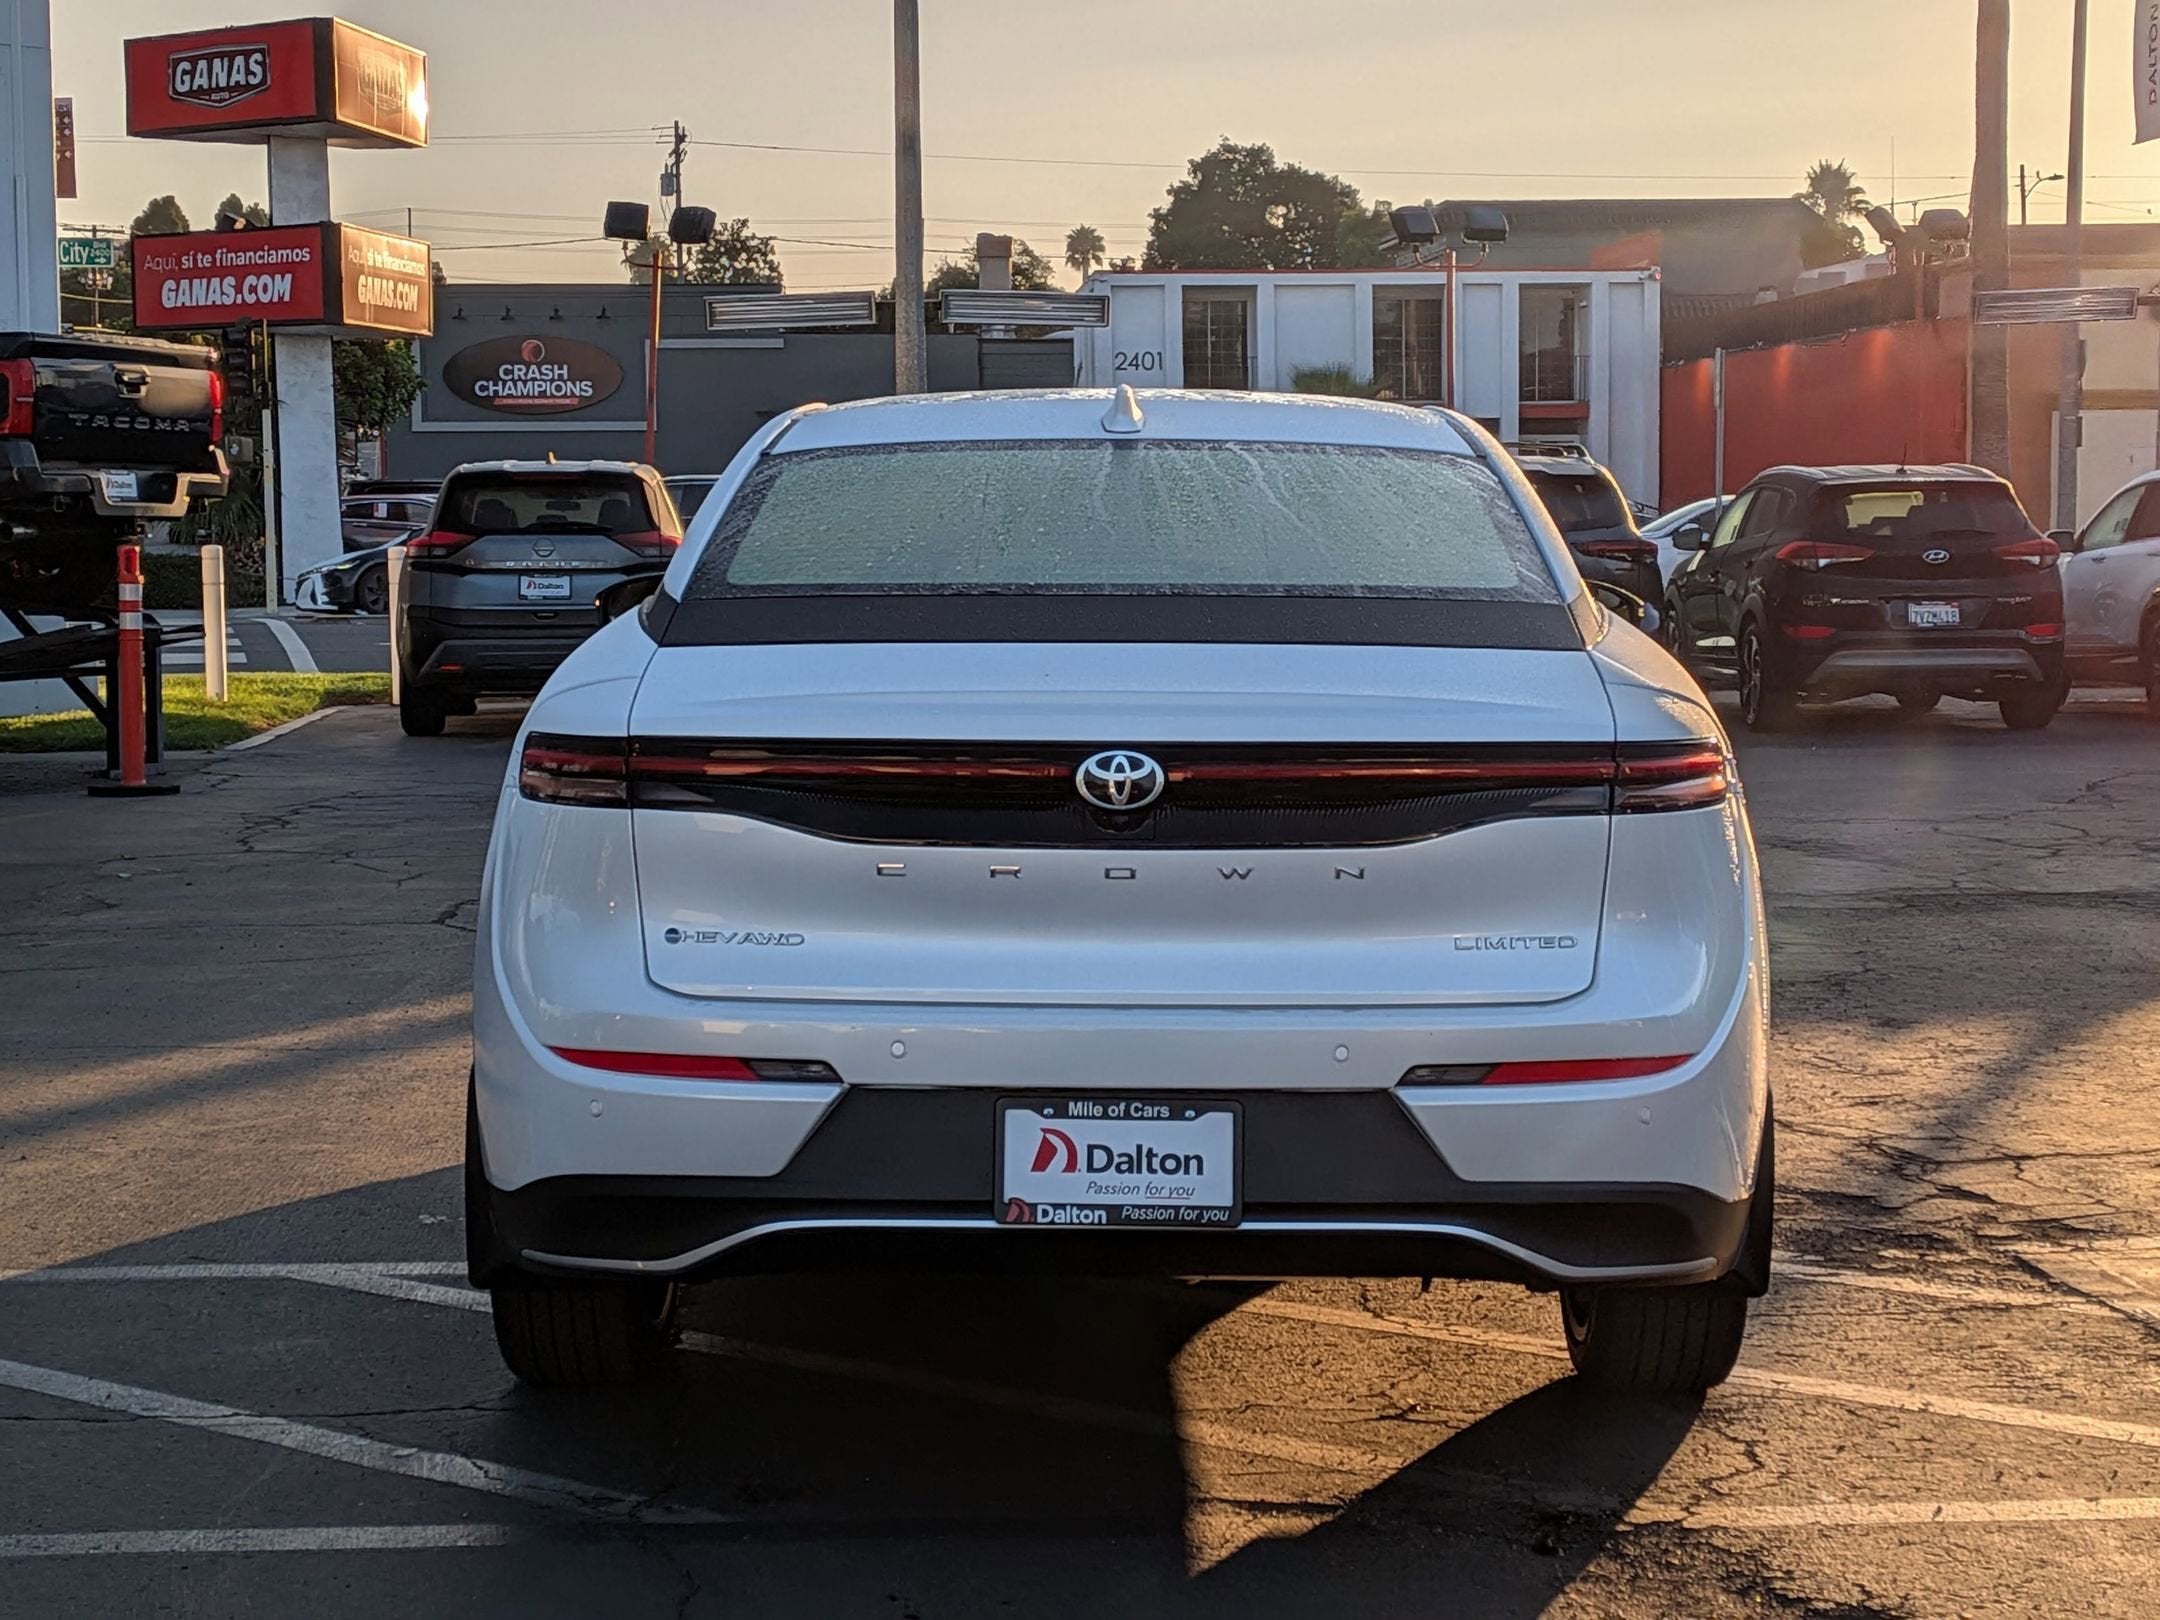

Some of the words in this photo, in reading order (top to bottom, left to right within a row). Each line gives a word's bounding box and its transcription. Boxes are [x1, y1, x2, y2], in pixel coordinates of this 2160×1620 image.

[2148, 3, 2159, 105] DALTON
[174, 52, 264, 93] GANAS
[59, 240, 89, 265] City
[197, 252, 212, 269] te
[215, 245, 311, 267] financiamos
[161, 273, 293, 309] GANAS.COM
[357, 274, 419, 313] GANAS.COM
[1114, 351, 1163, 371] 2401
[498, 364, 568, 380] CRASH
[474, 380, 593, 397] CHAMPIONS
[68, 413, 190, 432] TACOMA
[537, 582, 564, 590] Dalton
[877, 863, 1366, 880] CROWN
[1454, 936, 1578, 950] LIMITED
[1067, 1101, 1102, 1118] Mile
[1107, 1101, 1126, 1118] of
[1130, 1102, 1170, 1118] Cars
[1085, 1143, 1204, 1176] Dalton
[1085, 1181, 1140, 1196] Passion
[1143, 1181, 1165, 1198] for
[1168, 1186, 1196, 1199] you
[1036, 1205, 1108, 1225] Dalton
[1121, 1205, 1175, 1221] Passion
[1178, 1206, 1200, 1222] for
[1202, 1209, 1230, 1225] you
